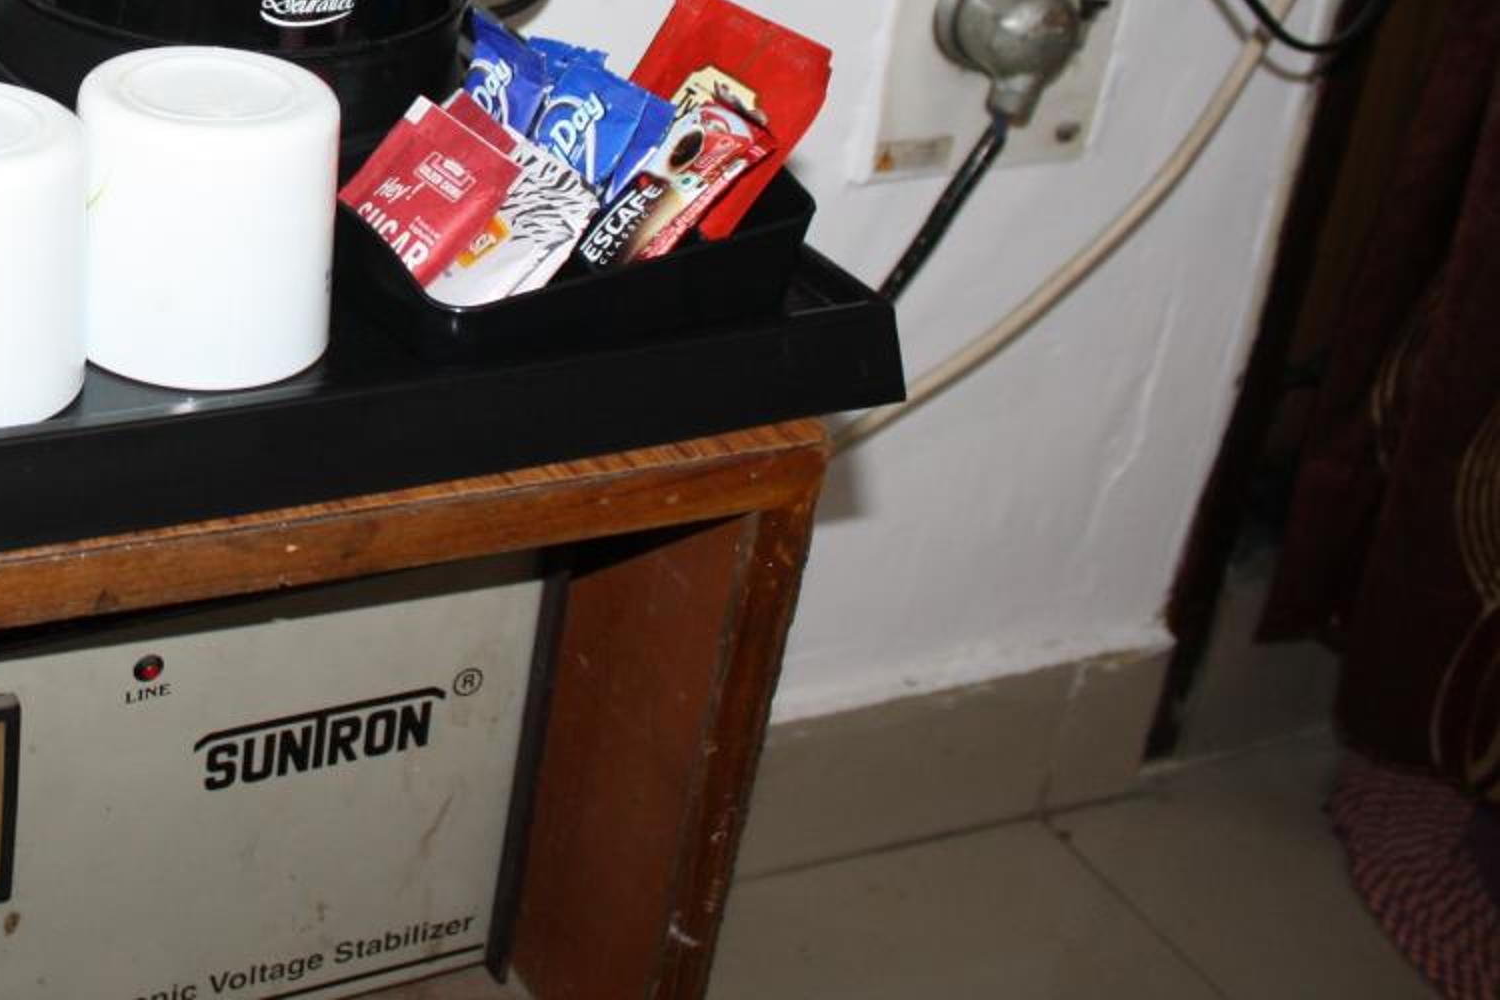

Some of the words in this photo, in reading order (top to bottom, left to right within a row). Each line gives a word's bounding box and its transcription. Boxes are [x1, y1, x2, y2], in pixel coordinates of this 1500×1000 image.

[125, 683, 173, 704] LINE
[195, 687, 447, 791] SUNTRON
[209, 953, 324, 996] Voltage
[333, 914, 475, 966] Stabilizer
